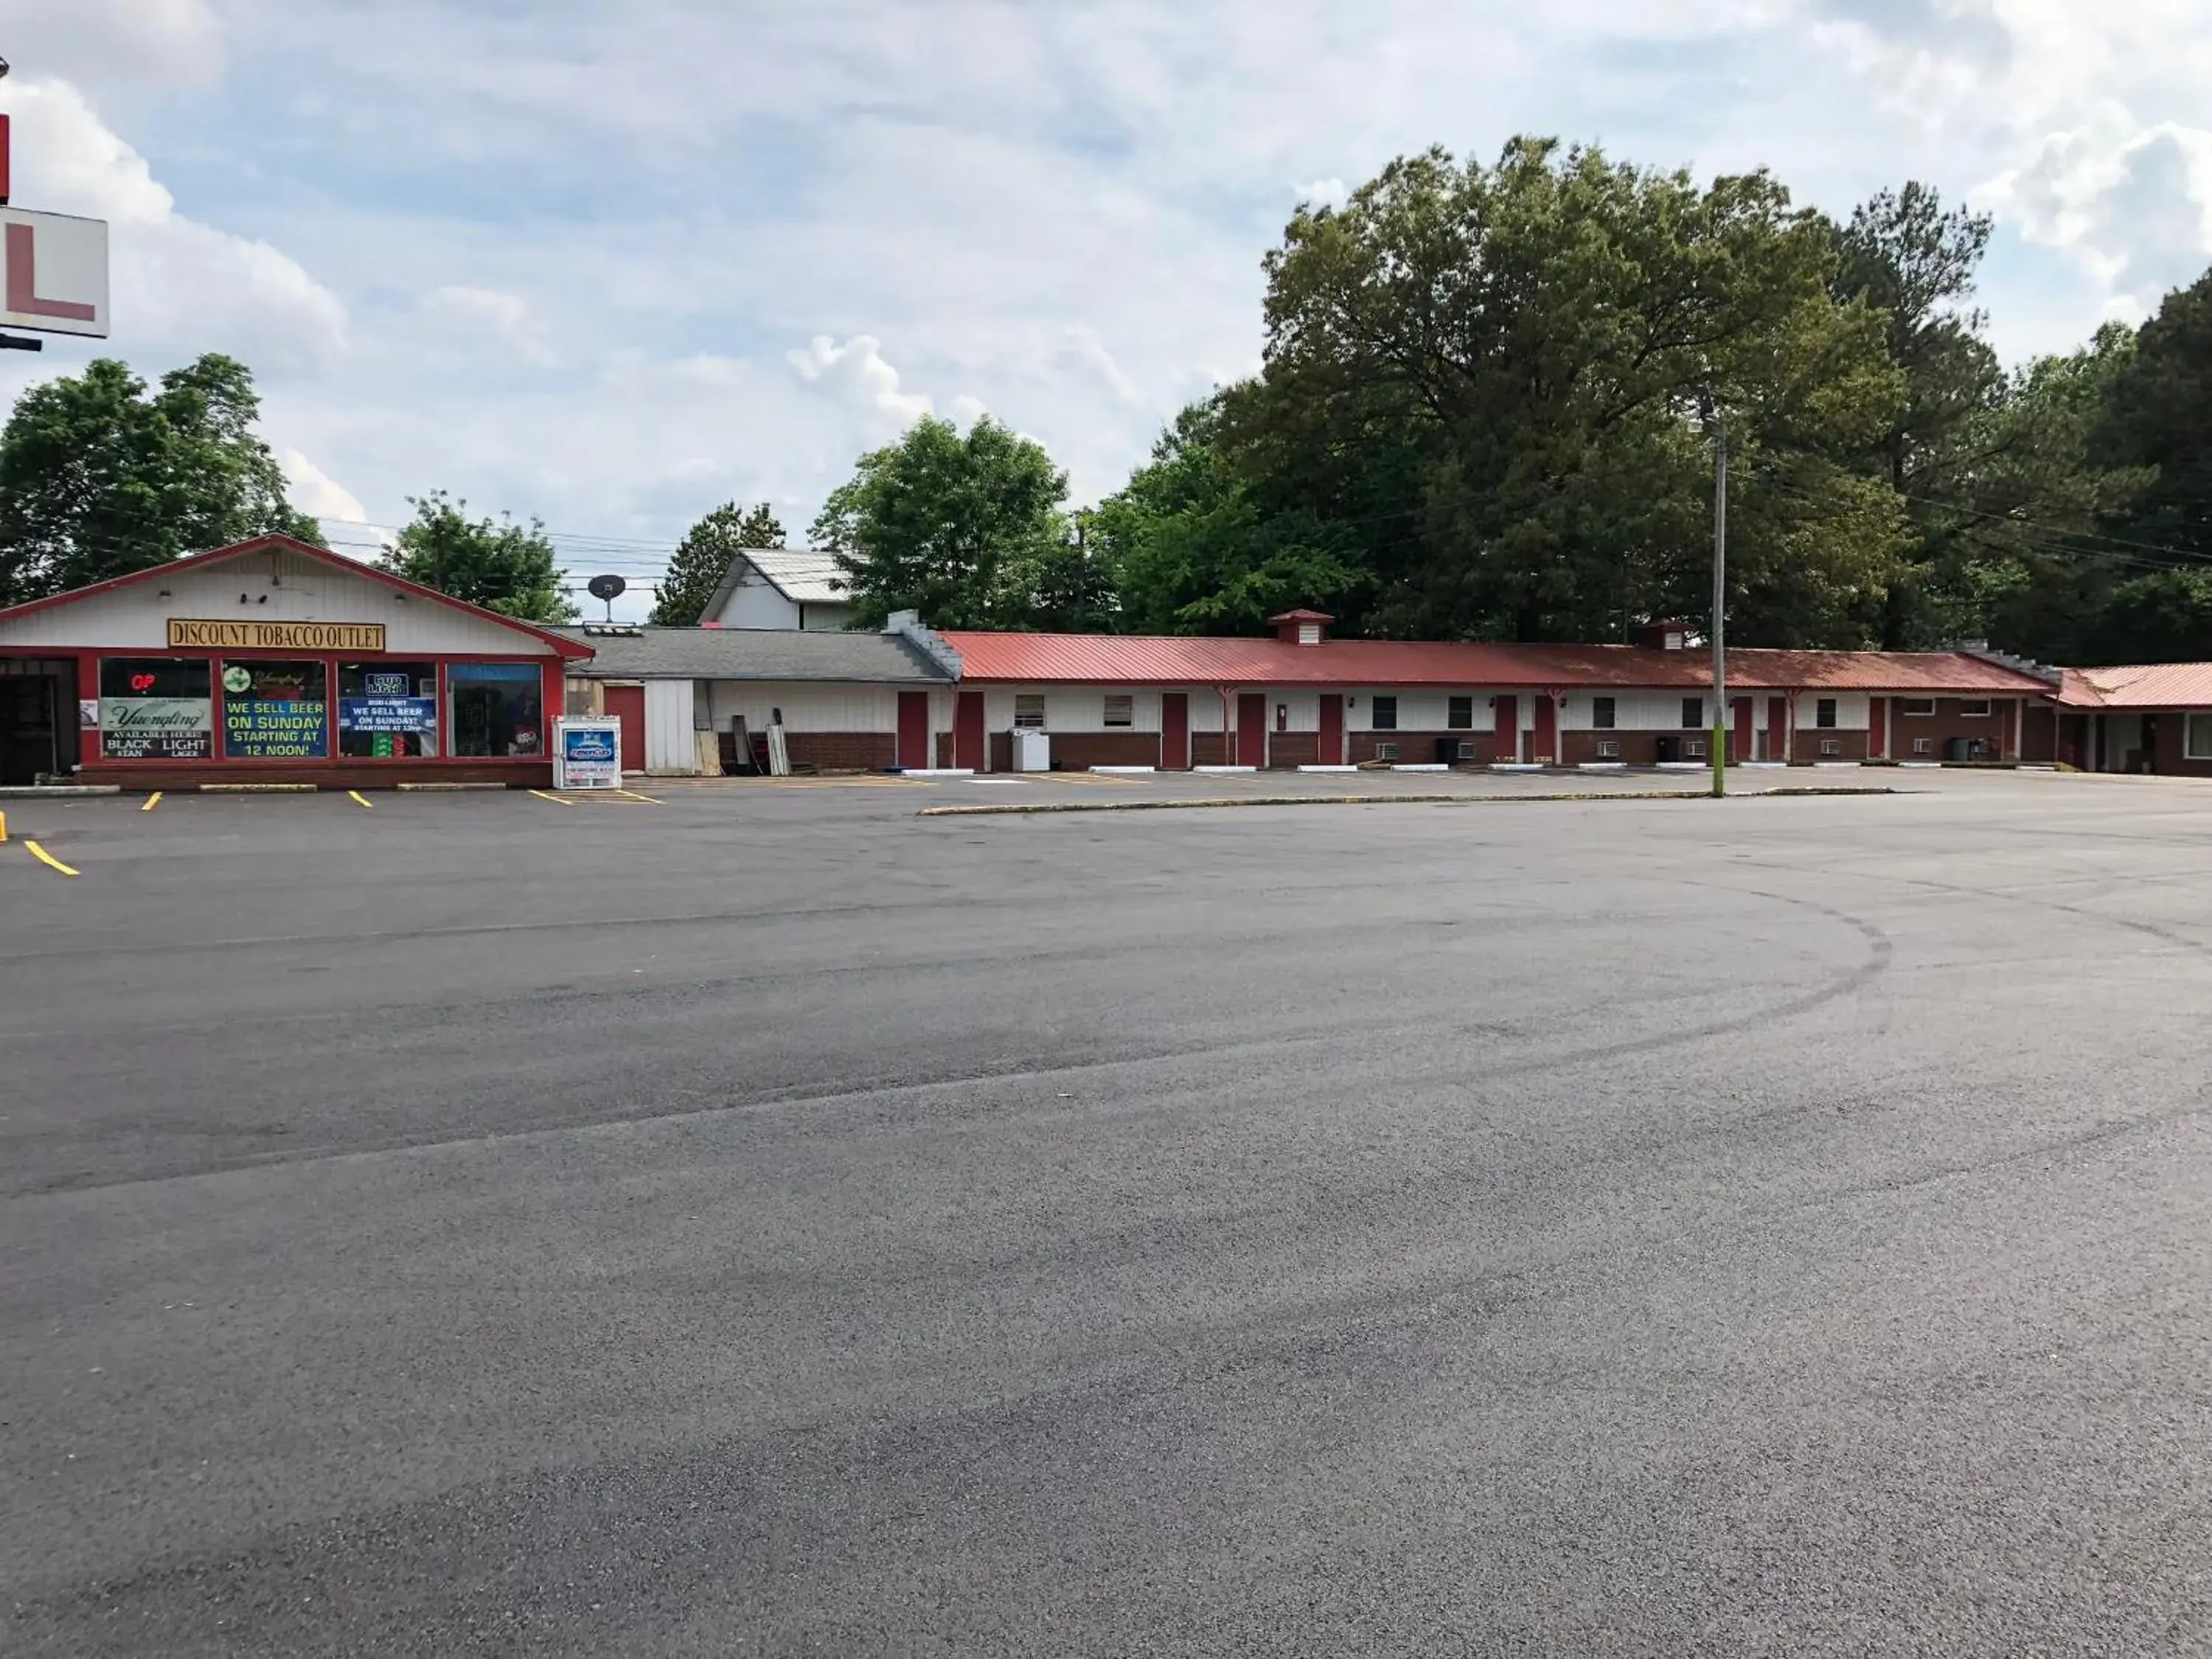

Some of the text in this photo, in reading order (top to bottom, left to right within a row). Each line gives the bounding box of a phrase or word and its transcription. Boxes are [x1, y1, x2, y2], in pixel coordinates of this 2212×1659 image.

[173, 623, 382, 647] DISCOUNT TOBACCO OUTLET
[227, 703, 324, 713] WE SELL BEER
[108, 706, 204, 729] Yuengling
[228, 716, 322, 729] ON SUNDAY
[358, 717, 372, 725] ON
[233, 731, 318, 742] STARTING AT
[107, 740, 206, 750] BLACK LIGHT
[246, 745, 309, 756] 12 NOON!
